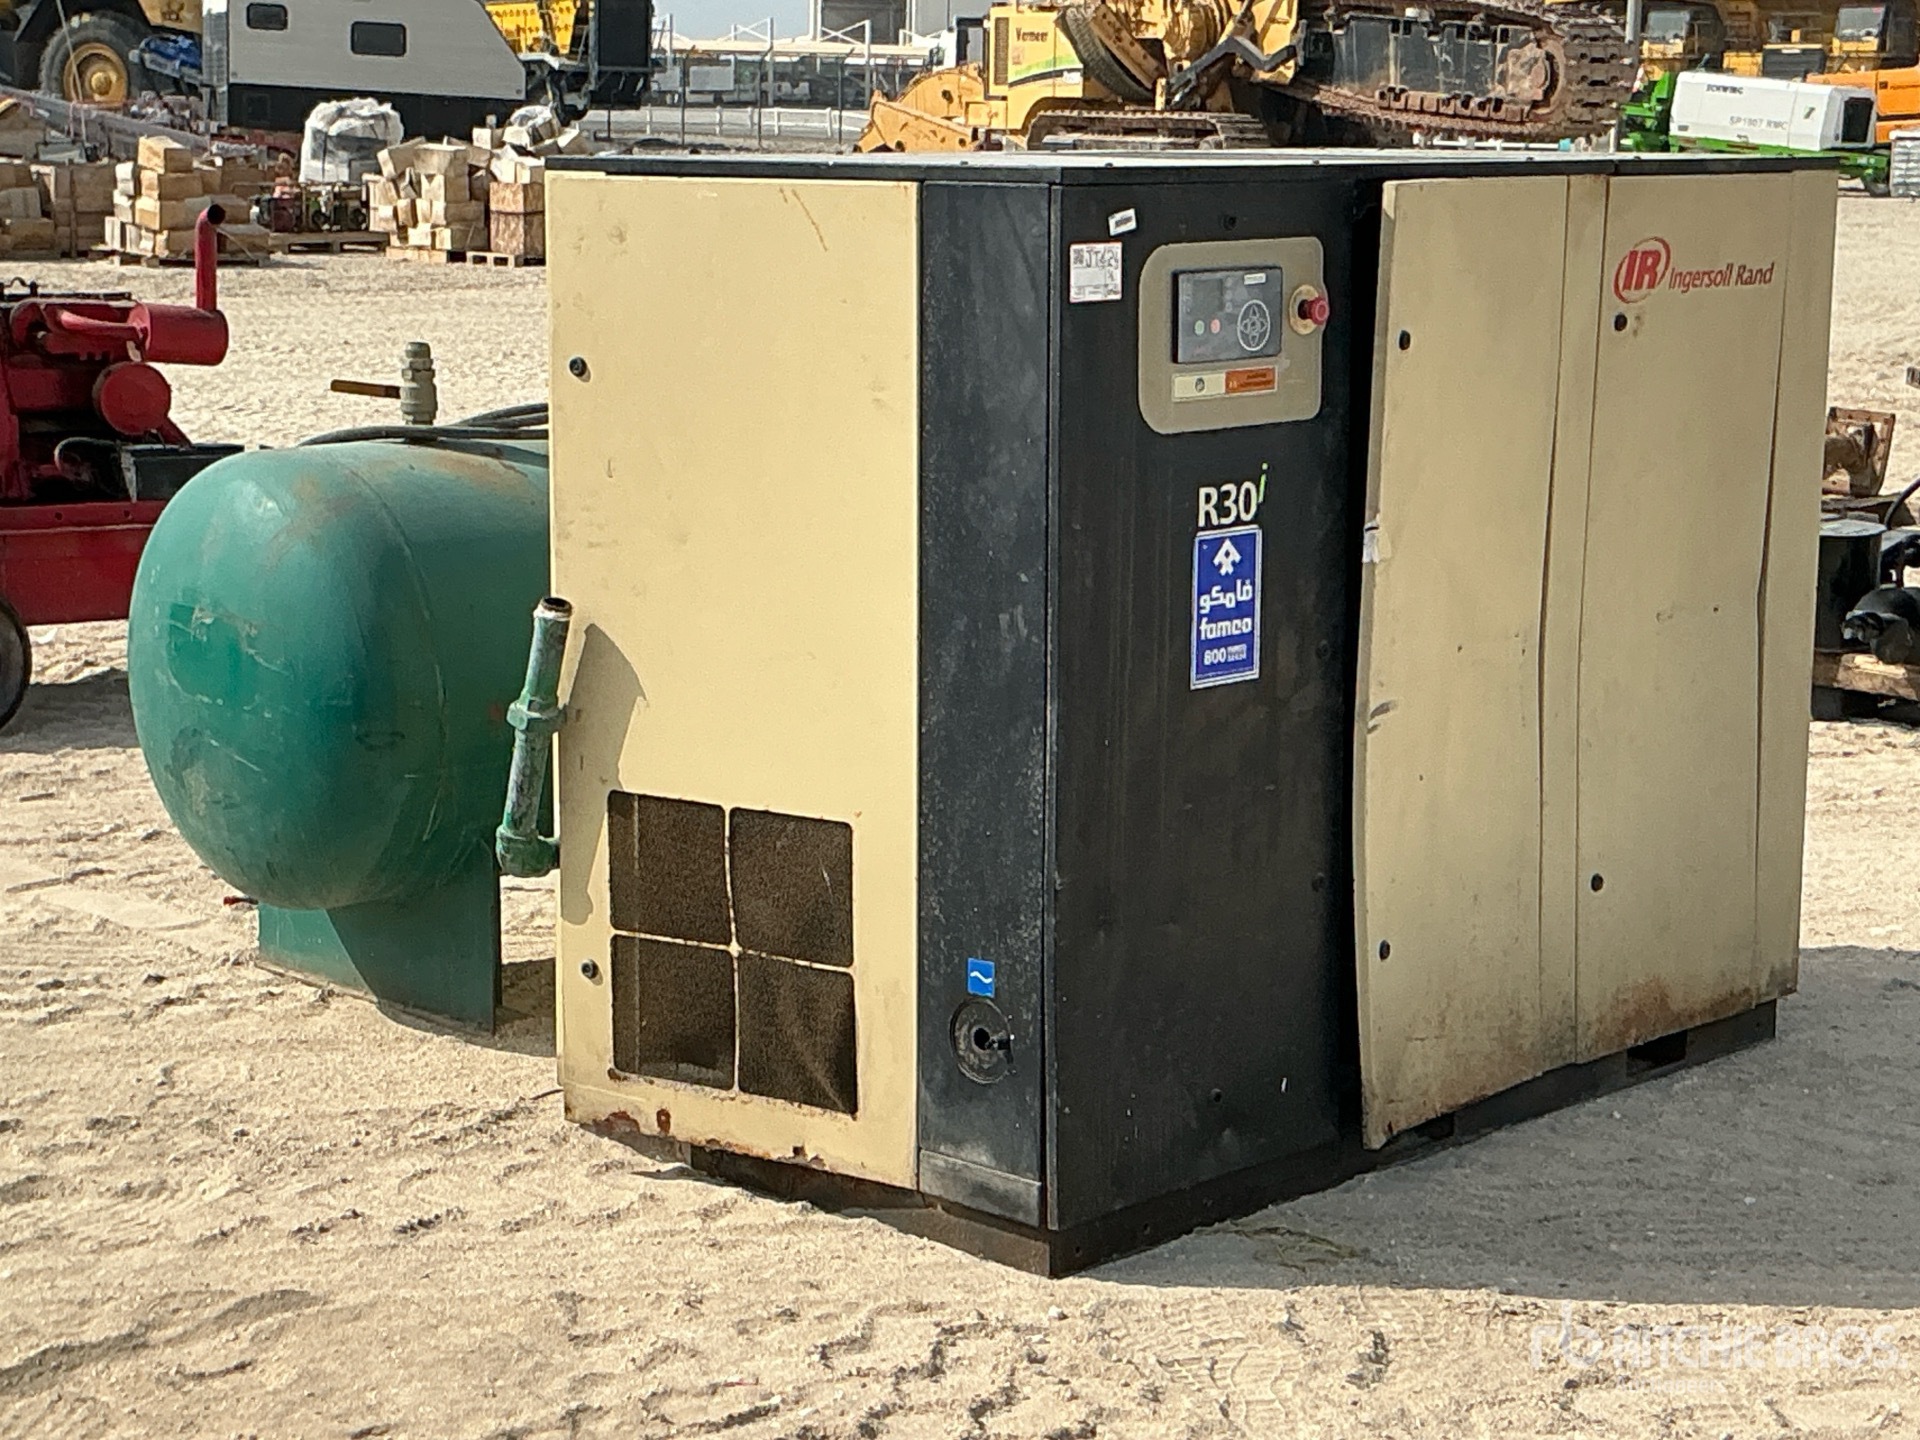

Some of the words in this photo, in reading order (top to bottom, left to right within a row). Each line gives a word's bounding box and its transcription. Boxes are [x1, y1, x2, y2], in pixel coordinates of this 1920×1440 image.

[1622, 249, 1661, 291] IR
[1734, 261, 1775, 287] Rand
[1199, 578, 1253, 614] فامكو
[1199, 617, 1253, 641] famco
